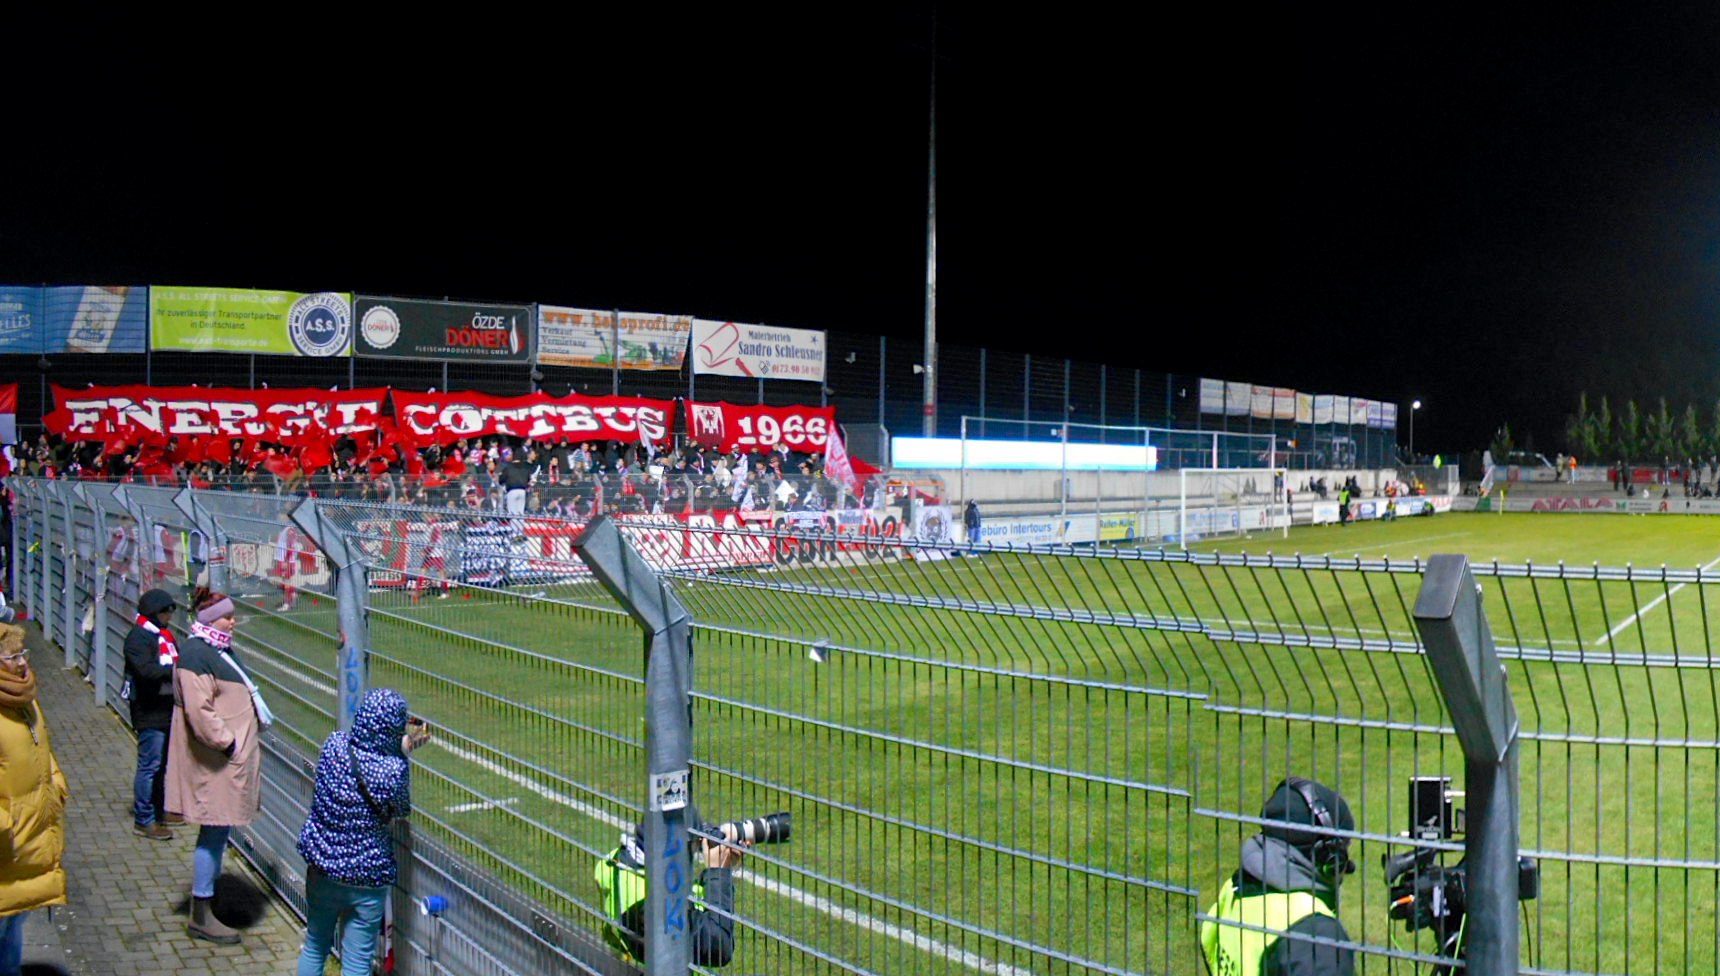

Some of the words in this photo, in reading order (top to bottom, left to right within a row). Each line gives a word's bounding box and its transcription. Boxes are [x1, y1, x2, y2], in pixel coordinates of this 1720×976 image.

[218, 309, 283, 322] Transportpartner
[472, 311, 505, 330] ÖZDE
[305, 317, 336, 333] A.S.S.
[446, 324, 510, 349] DÖNER
[541, 334, 587, 348] Vermietung
[748, 330, 792, 343] Malerbetrieb
[415, 345, 489, 355] FLEISCHPRODUKTIONS
[738, 341, 773, 358] Sandro
[775, 343, 823, 362] Schleusner
[403, 402, 668, 441] COTTBUS
[737, 413, 829, 446] 1966
[981, 522, 1008, 537] ebüro
[1009, 521, 1053, 536] Intertours
